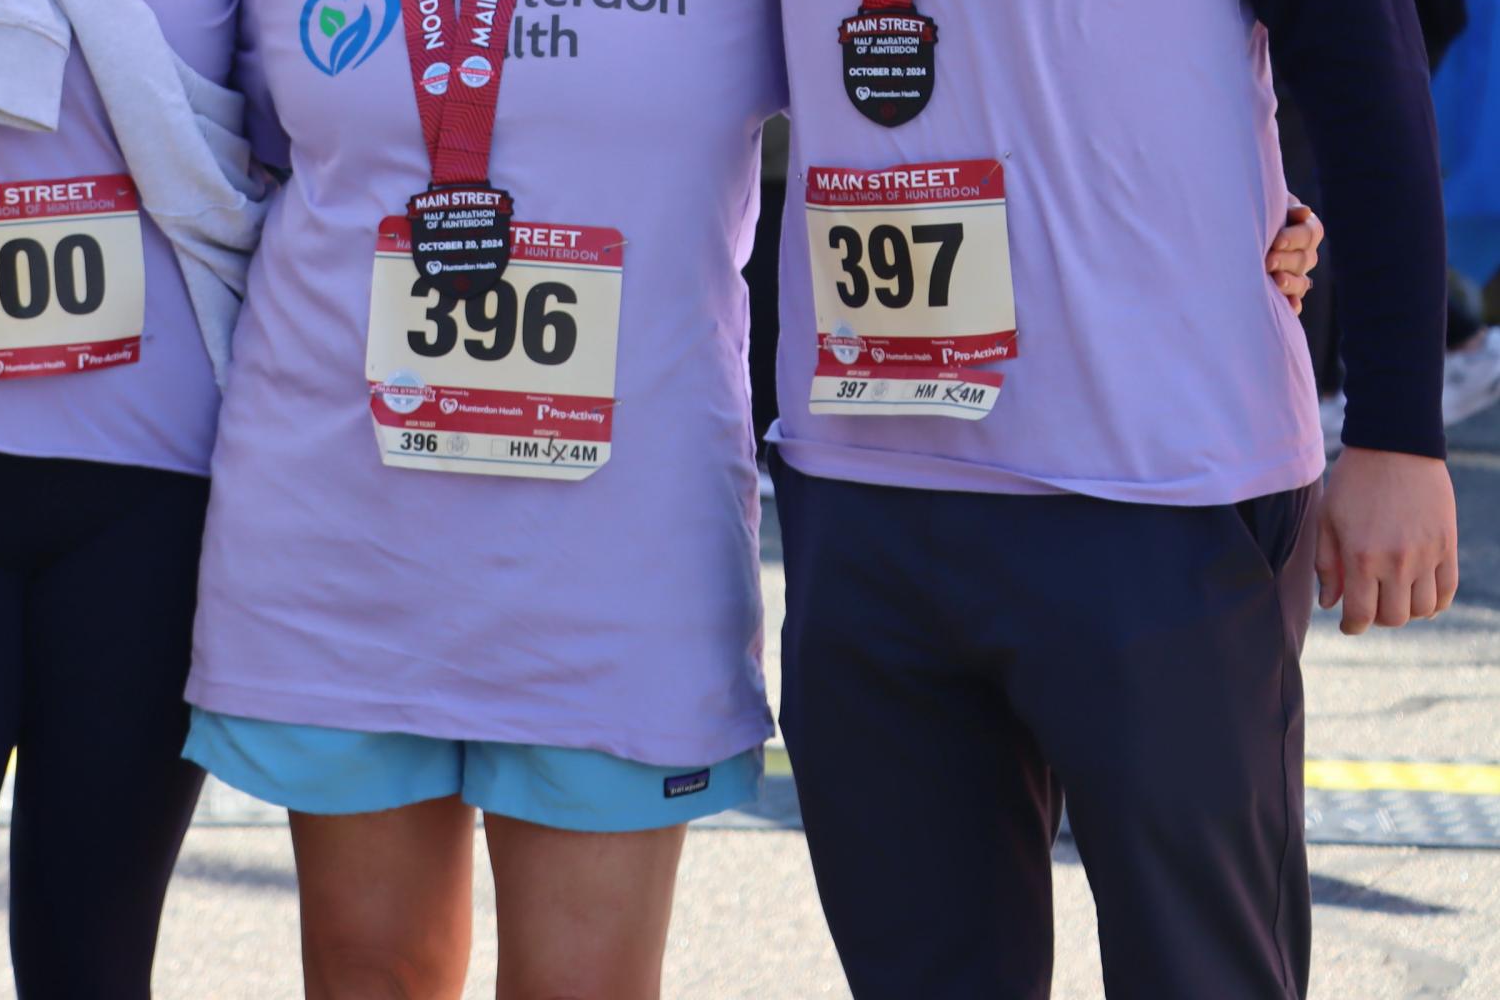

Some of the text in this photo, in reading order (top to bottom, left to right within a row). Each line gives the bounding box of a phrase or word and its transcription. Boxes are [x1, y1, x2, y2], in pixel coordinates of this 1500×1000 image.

[847, 18, 925, 33] MAIN STREET
[854, 37, 920, 45] HALF MARATHON
[856, 46, 918, 54] OF HUNTERDON
[849, 67, 926, 77] OCTOBER 20, 2024
[817, 168, 959, 190] MAIN STREET
[4, 182, 96, 204] STREET
[416, 191, 501, 209] MAIN STREET
[829, 190, 883, 201] MARATHON
[886, 190, 900, 200] OF
[905, 186, 979, 200] HUNTERDON
[25, 205, 41, 215] OF
[47, 199, 115, 213] HUNTERDON
[423, 209, 496, 220] HALF MARATHON
[426, 219, 494, 229] OF HUNTERDON
[418, 238, 503, 252] OCTOBER 20, 2024
[525, 247, 599, 262] HUNTERDON
[828, 222, 964, 309] 397
[407, 278, 578, 366] 396
[89, 350, 133, 366] Pro-Activity
[886, 352, 932, 361] Hunterdon Health
[954, 346, 1008, 362] Pro-Activity
[400, 388, 428, 396] STREET
[836, 381, 868, 398] 397
[914, 383, 986, 404] HM 4M
[459, 404, 523, 416] Hunterdon Health
[550, 409, 605, 424] Pro-Activity
[400, 432, 438, 453] 396
[510, 441, 598, 462] HM 4M
